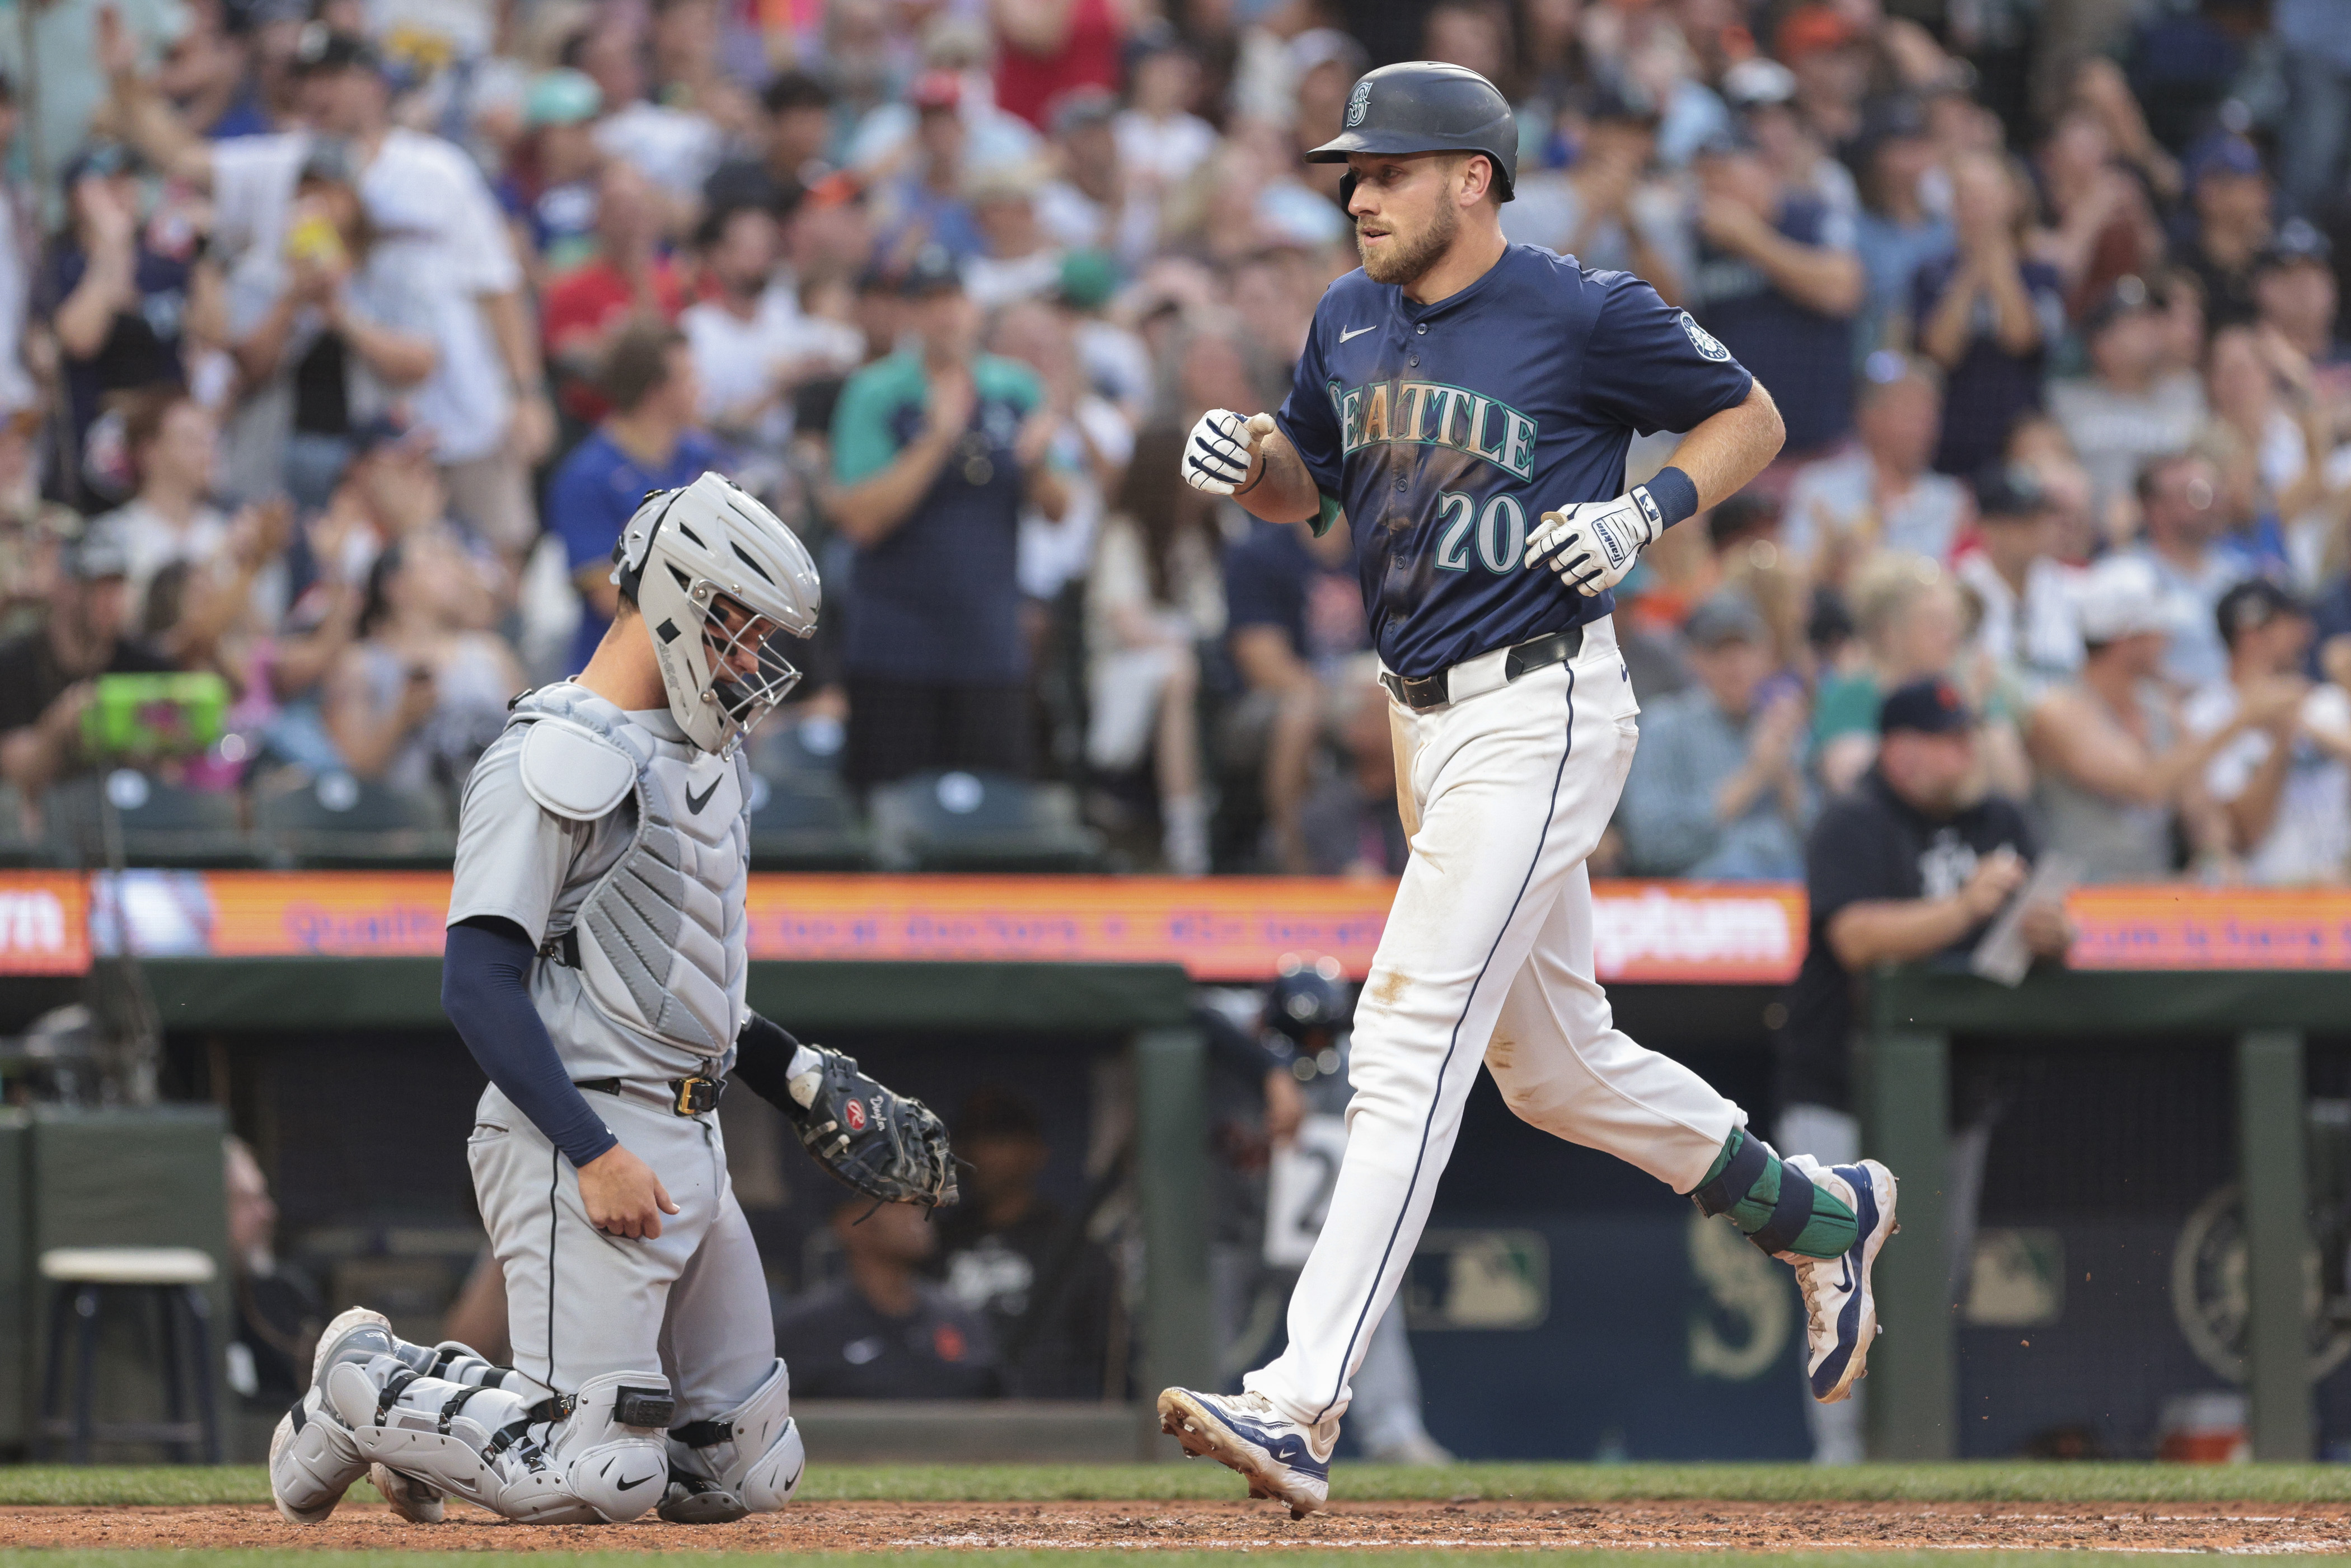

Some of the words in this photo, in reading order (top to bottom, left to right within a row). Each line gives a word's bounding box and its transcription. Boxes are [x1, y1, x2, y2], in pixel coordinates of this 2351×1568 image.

[1347, 82, 1373, 128] S
[1325, 380, 1539, 483] SEATTLE
[1434, 490, 1529, 575] 20
[1595, 522, 1623, 563] Franklin
[1593, 886, 1789, 977] ptum
